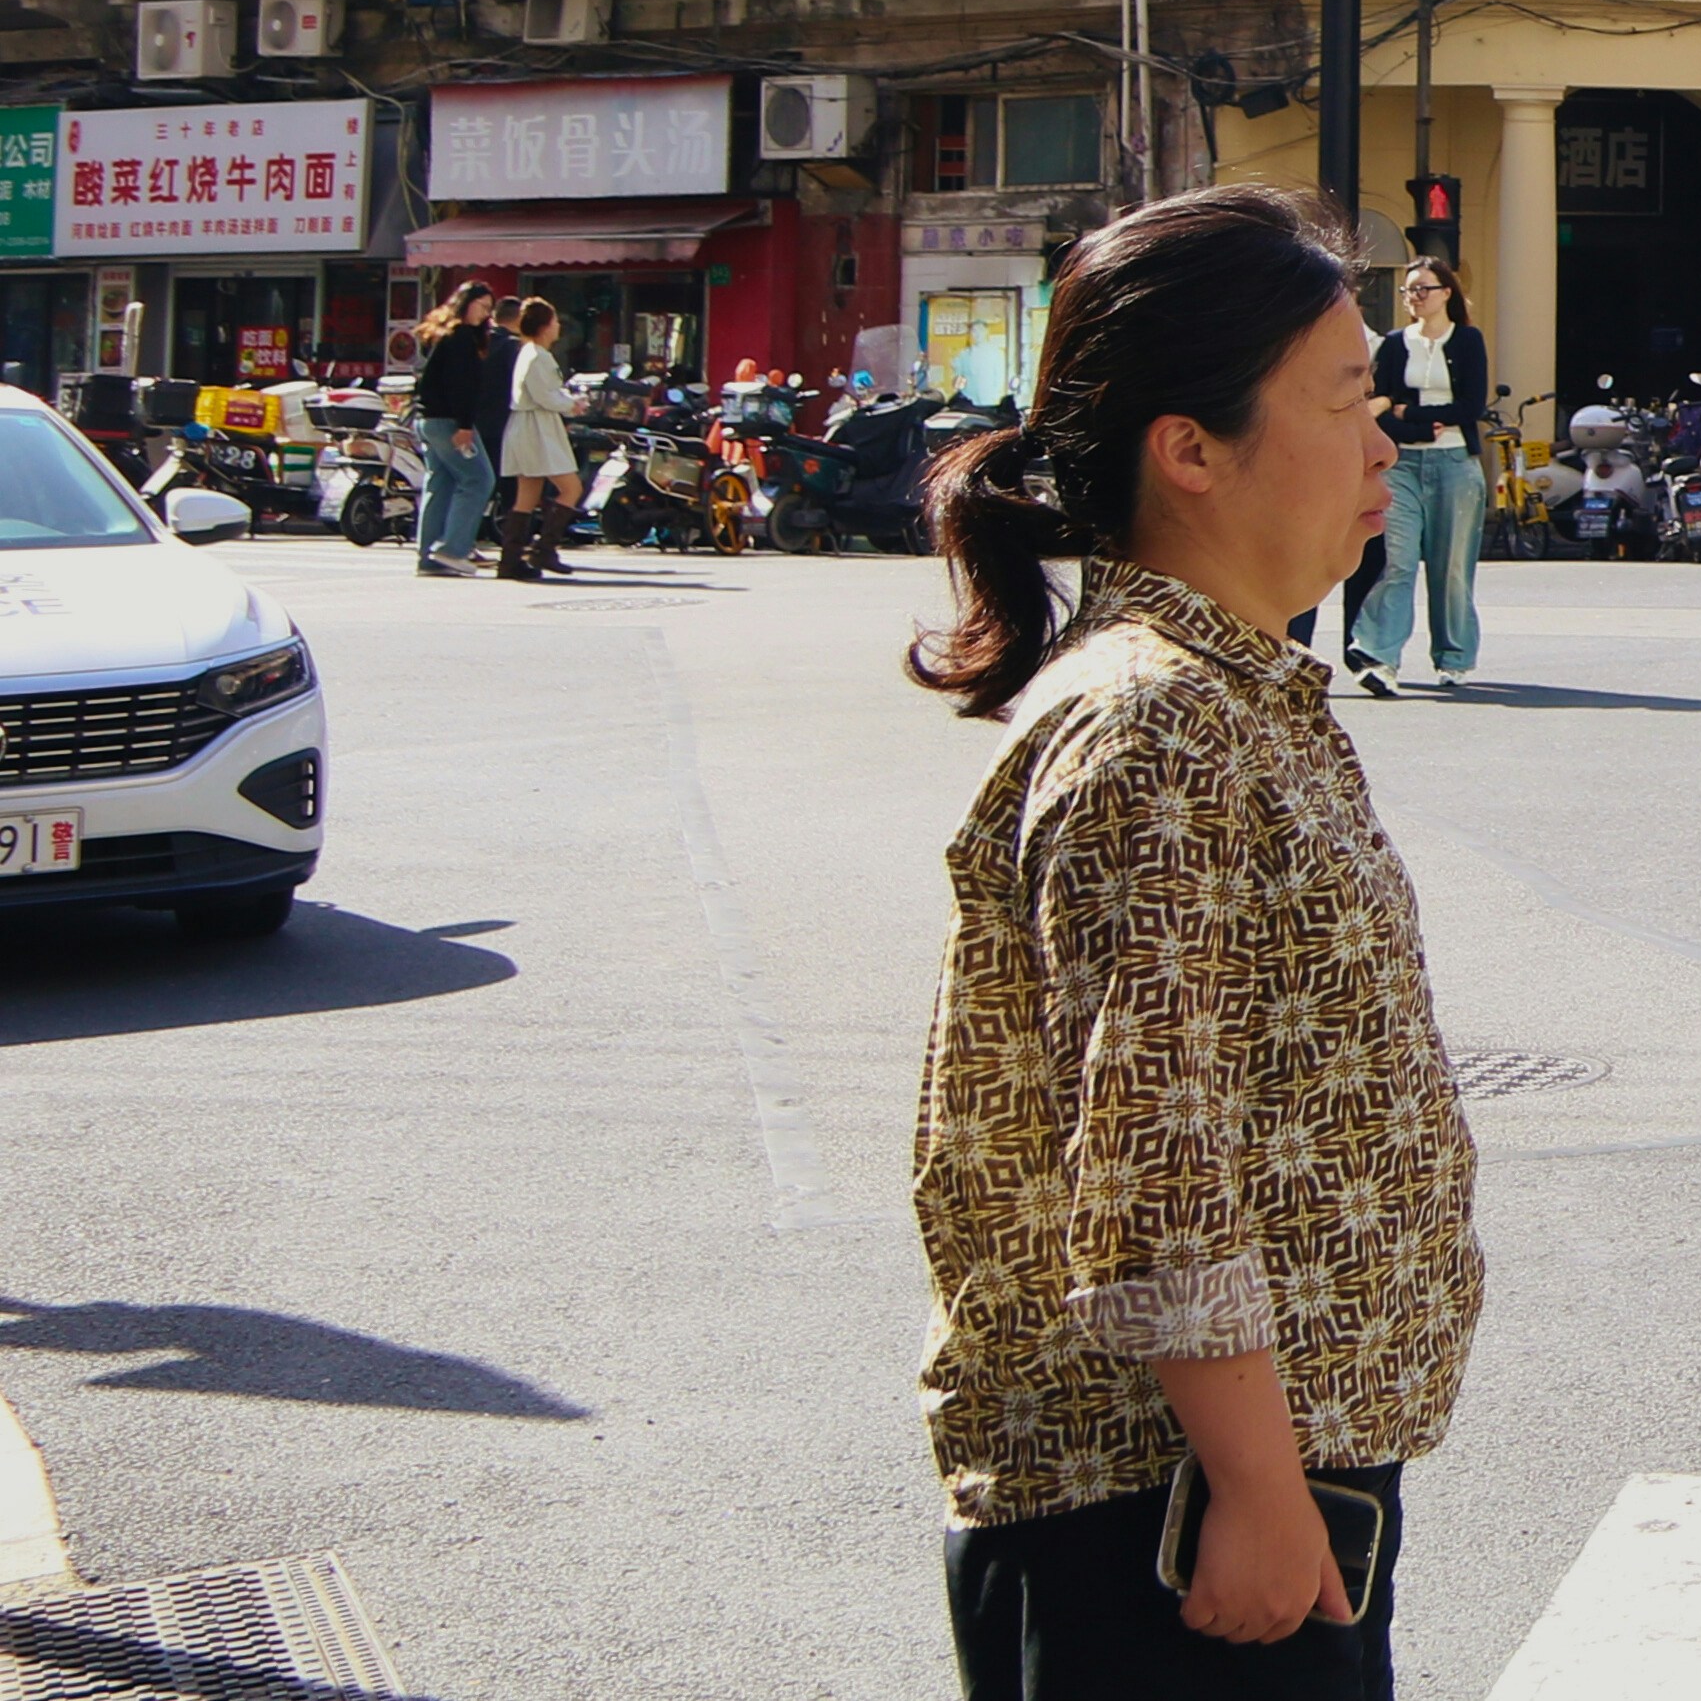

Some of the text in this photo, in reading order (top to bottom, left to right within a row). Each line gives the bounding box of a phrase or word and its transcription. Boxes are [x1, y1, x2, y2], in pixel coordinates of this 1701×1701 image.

[0, 132, 54, 167] 公司
[156, 119, 264, 140] 三十年老店
[449, 109, 714, 182] 菜饭骨头汤
[74, 152, 336, 206] 酸菜红烧牛肉面
[1560, 127, 1648, 187] 酒店
[130, 220, 192, 237] 红烧牛肉面
